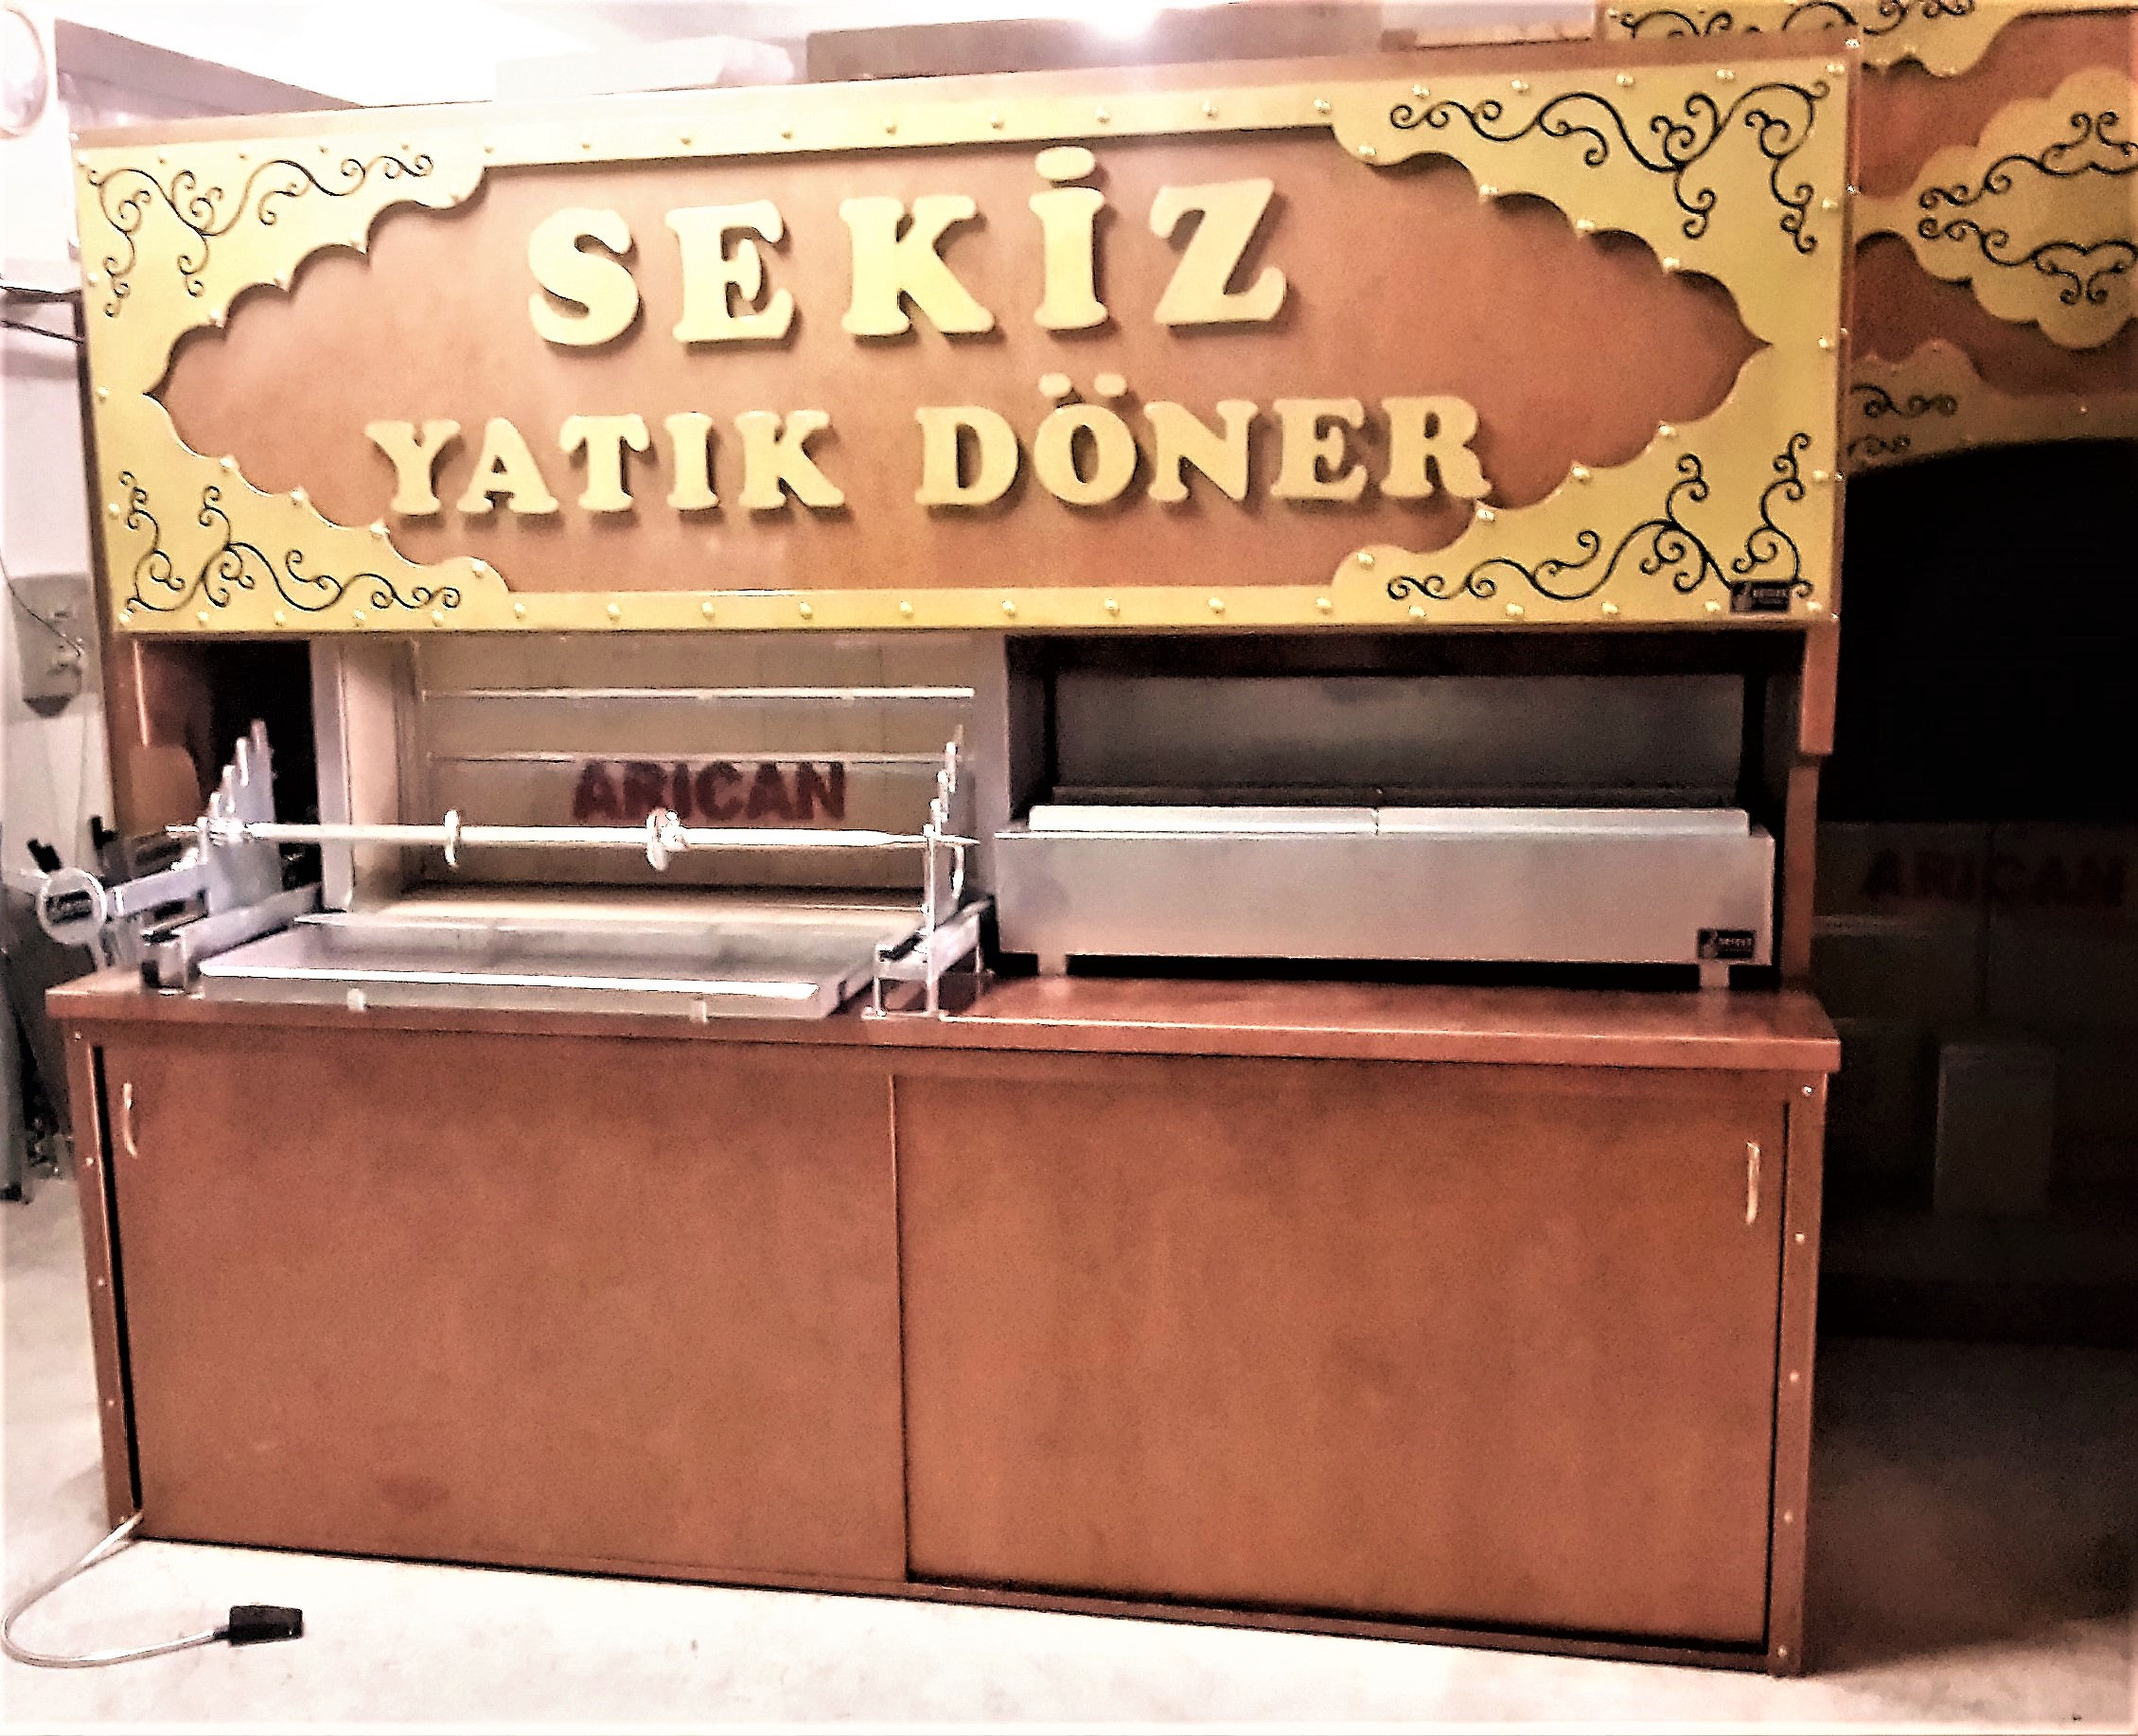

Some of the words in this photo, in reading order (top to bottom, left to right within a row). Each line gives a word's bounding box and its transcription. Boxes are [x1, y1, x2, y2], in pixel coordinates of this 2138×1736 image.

[528, 147, 1287, 347] SEKİZ
[364, 409, 845, 516] YATIK
[914, 373, 1493, 506] DÖNER
[573, 760, 846, 822] ARICAN
